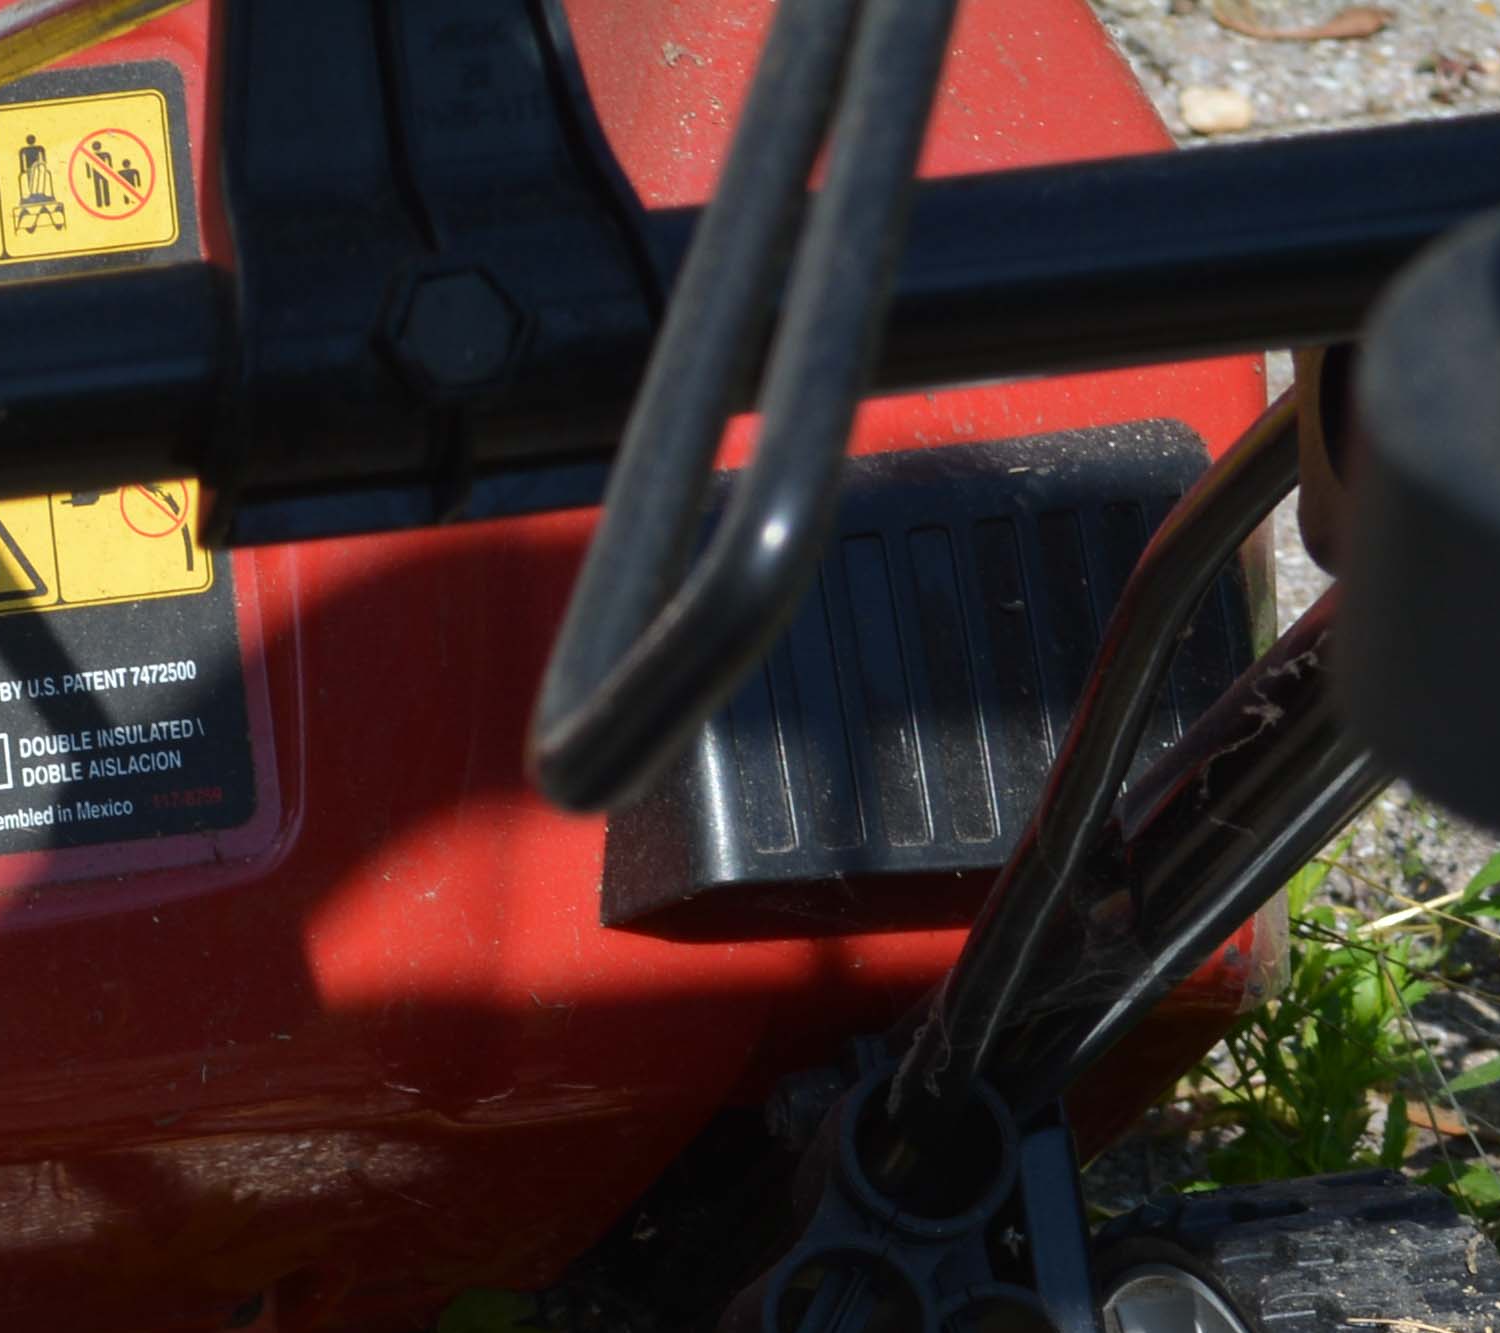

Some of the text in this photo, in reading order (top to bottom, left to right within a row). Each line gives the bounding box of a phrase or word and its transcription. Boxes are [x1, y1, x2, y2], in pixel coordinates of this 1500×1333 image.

[0, 680, 23, 702] BY
[27, 677, 60, 698] U.S.
[63, 668, 127, 694] PATENT
[130, 660, 196, 687] 7472500
[19, 731, 92, 758] DOUBLE
[97, 719, 194, 748] INSULATED
[22, 750, 181, 787] DOBLE AISLACION
[58, 804, 72, 822] in
[77, 800, 133, 820] Mexico
